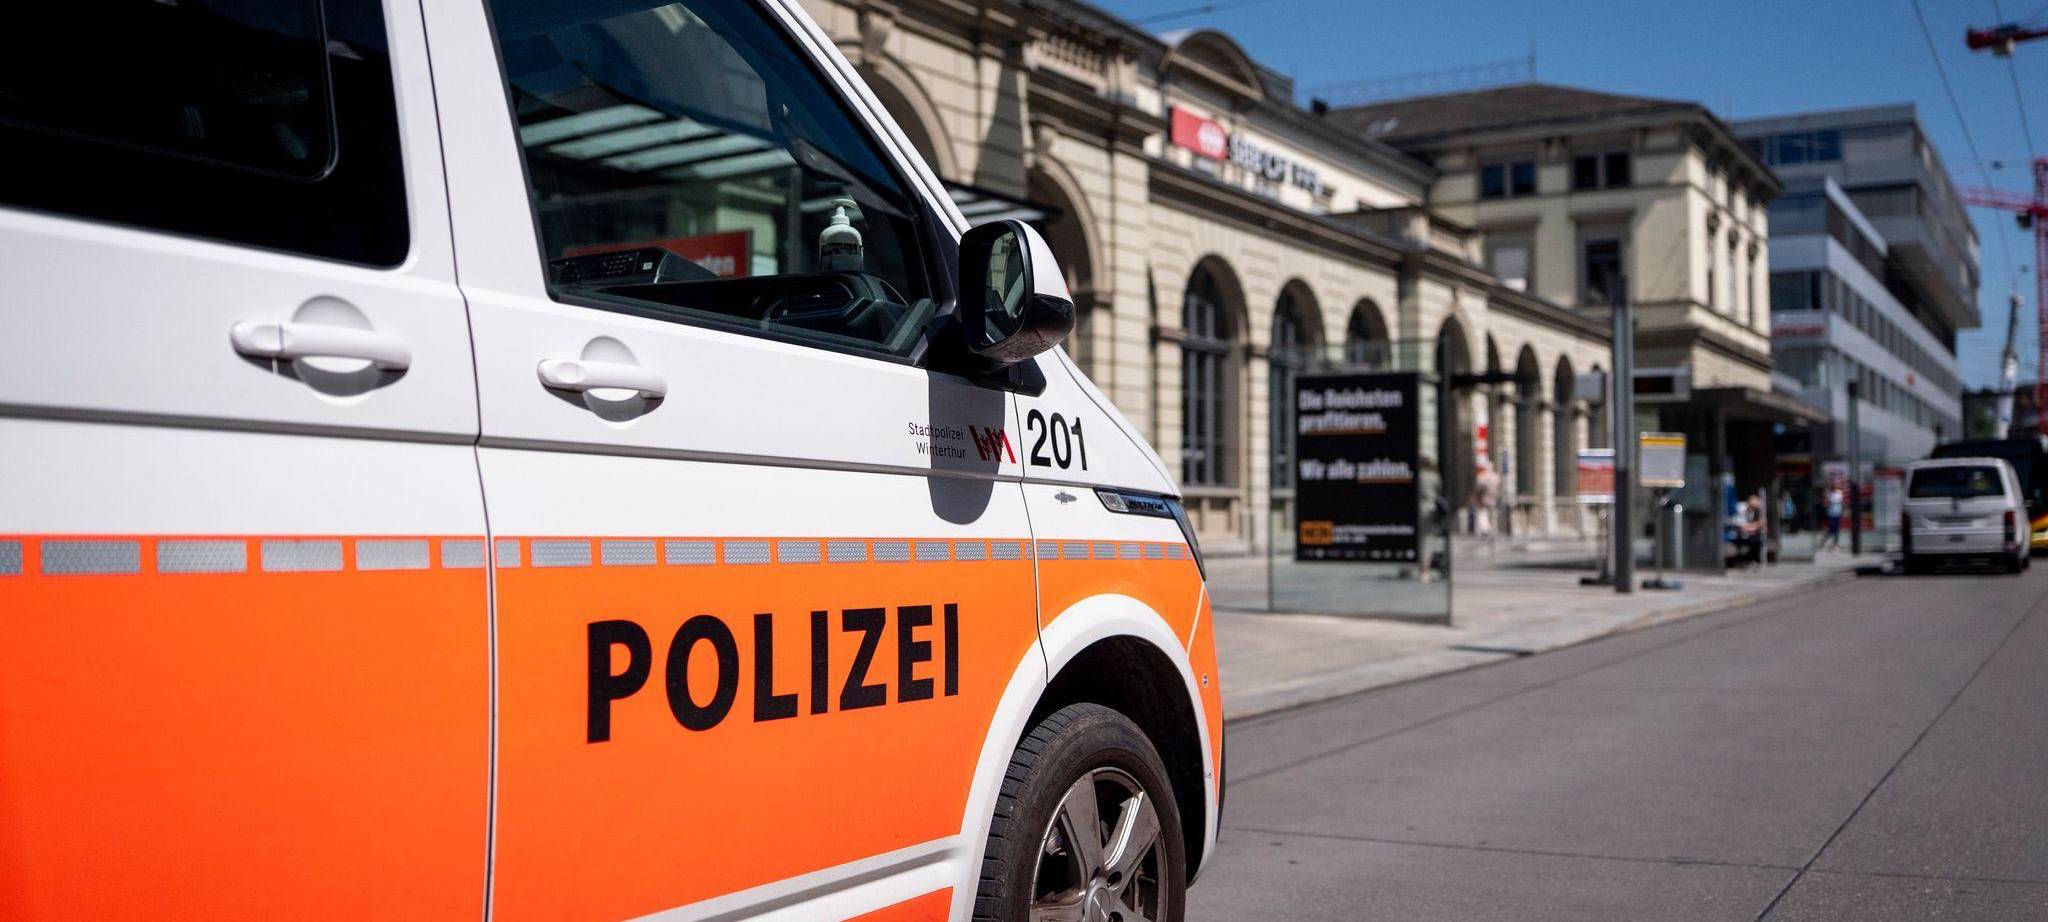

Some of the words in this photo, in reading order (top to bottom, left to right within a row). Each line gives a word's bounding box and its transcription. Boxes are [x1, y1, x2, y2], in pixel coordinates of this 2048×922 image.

[1299, 389, 1322, 410] Die
[1324, 387, 1403, 409] Reichsten
[908, 422, 964, 440] Stadtpolizei
[1299, 410, 1387, 435] profitieren.
[915, 441, 966, 458] Winterthur
[1026, 408, 1088, 471] 201
[1300, 459, 1325, 480] Wir
[1326, 458, 1355, 480] alle
[1357, 458, 1413, 480] zahlen.
[586, 603, 958, 744] POLIZEI
